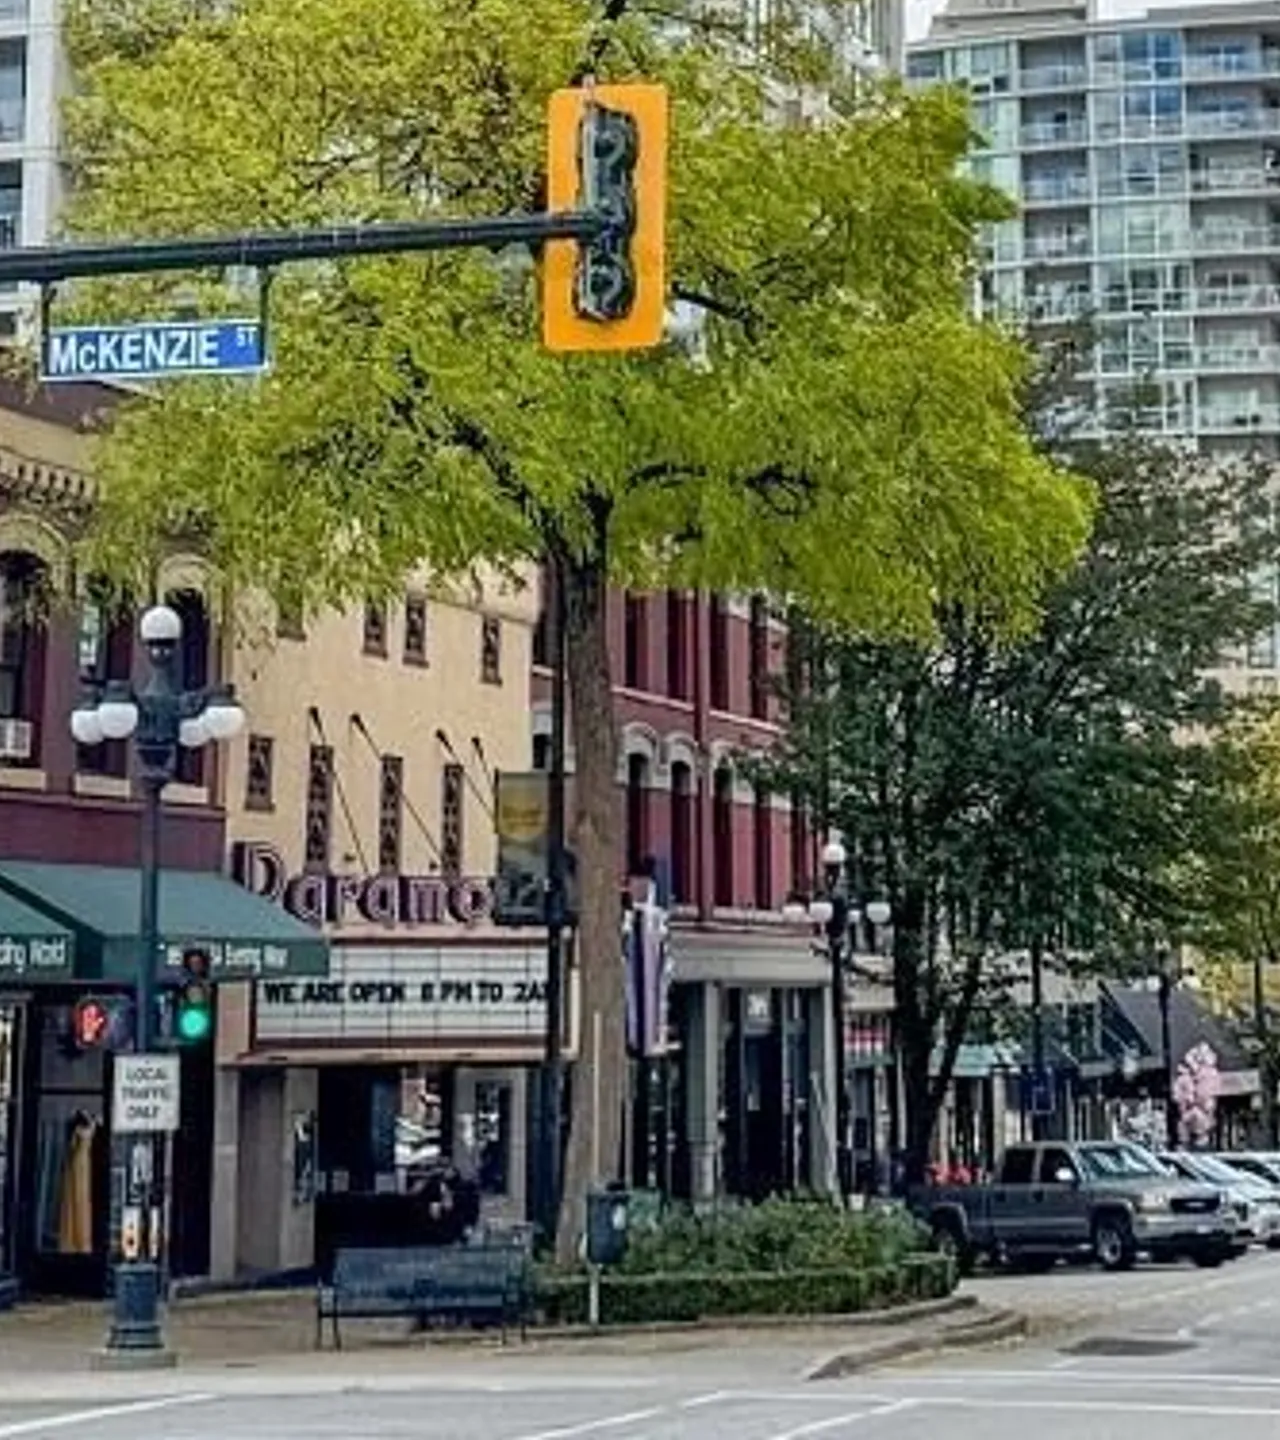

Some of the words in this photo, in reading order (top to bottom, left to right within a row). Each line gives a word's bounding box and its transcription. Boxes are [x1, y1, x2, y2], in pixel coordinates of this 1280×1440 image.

[50, 328, 220, 374] McKENZIE
[235, 326, 258, 348] ST
[263, 982, 297, 1004] WE
[301, 981, 346, 1004] ARE
[349, 981, 406, 1003] OPEN
[476, 981, 504, 1002] TO
[513, 980, 549, 1003] 2A
